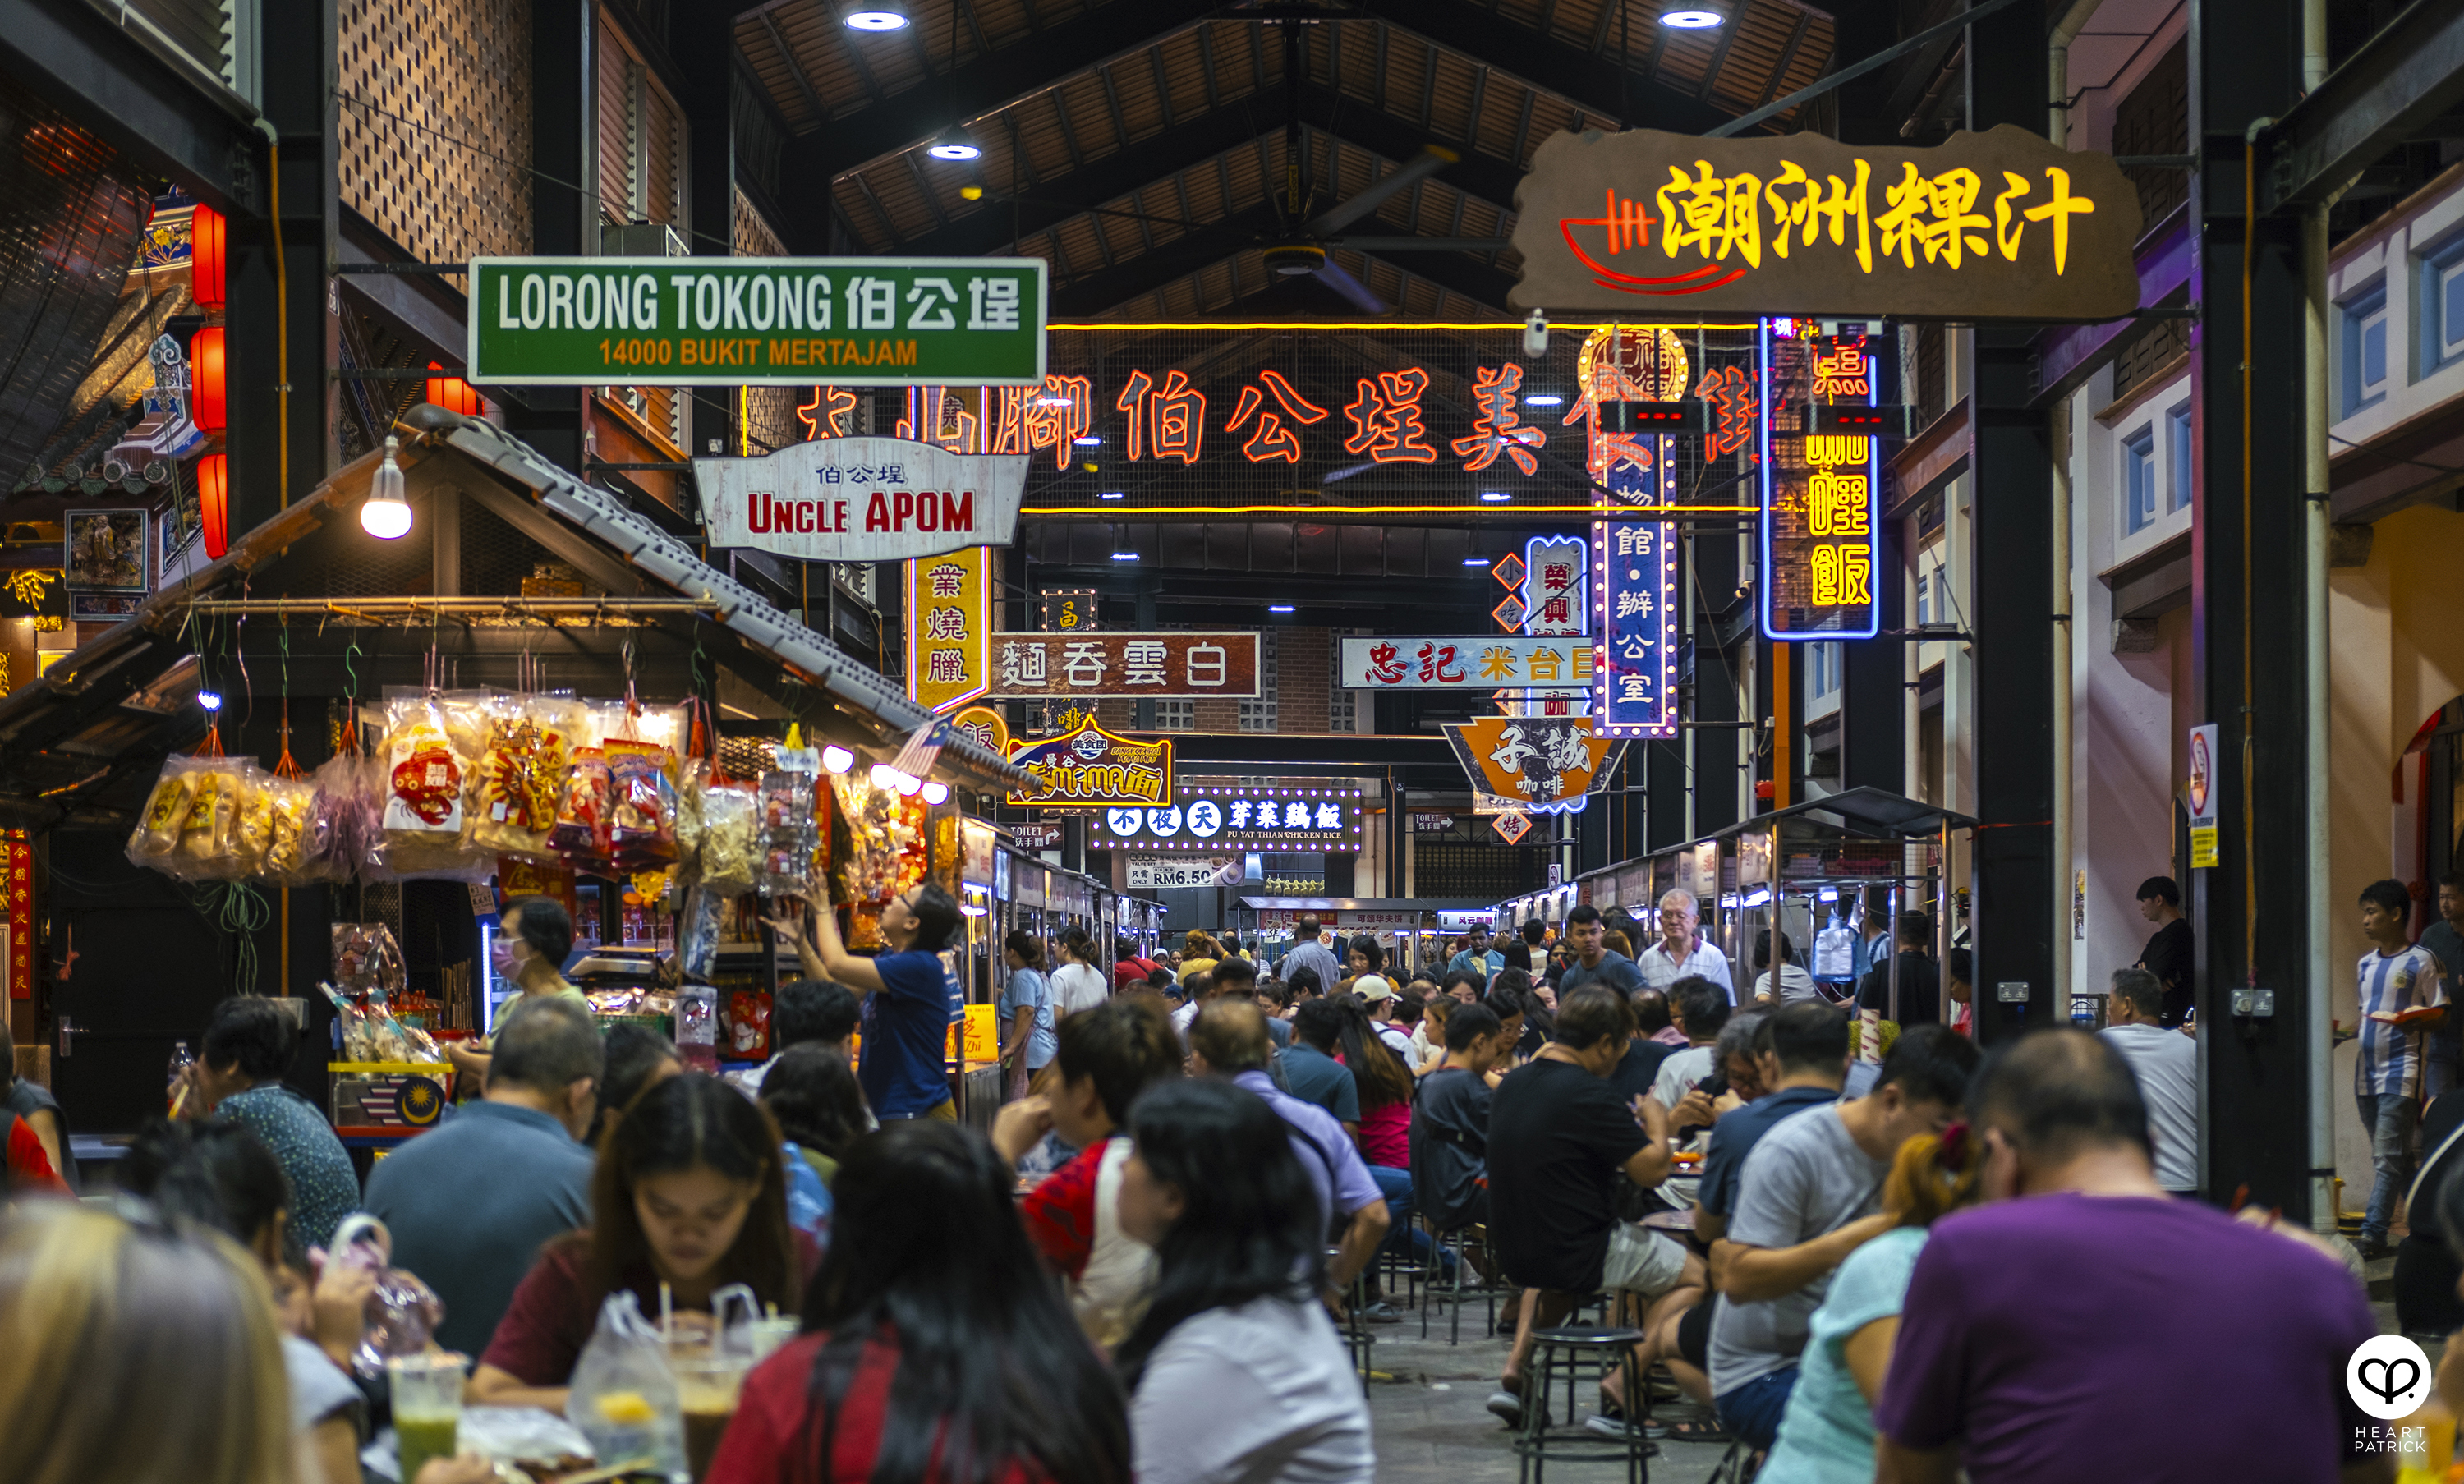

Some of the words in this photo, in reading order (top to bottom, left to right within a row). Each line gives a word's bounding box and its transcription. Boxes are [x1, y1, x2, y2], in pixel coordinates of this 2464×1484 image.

[1657, 159, 2094, 276] 潮洲粿汁
[499, 273, 658, 330] LORONG
[671, 273, 832, 330] TOKONG
[845, 277, 1020, 331] 伯公埕
[600, 339, 672, 366] 14000
[681, 339, 762, 366] BUKIT
[769, 339, 917, 367] MERTAJAM
[815, 464, 907, 486] 伯公埕
[866, 491, 973, 533] APOM
[1046, 753, 1077, 769] 曼谷
[1516, 775, 1565, 797] 咖啡
[1416, 814, 1440, 824] TOILET
[1011, 826, 1042, 836] TOILET
[1227, 830, 1238, 838] PU
[1240, 830, 1255, 838] YAT
[1257, 830, 1284, 838] THIAN
[1284, 831, 1321, 839] CHICKEN
[1323, 831, 1342, 839] RICE
[1153, 869, 1211, 885] RM6.50
